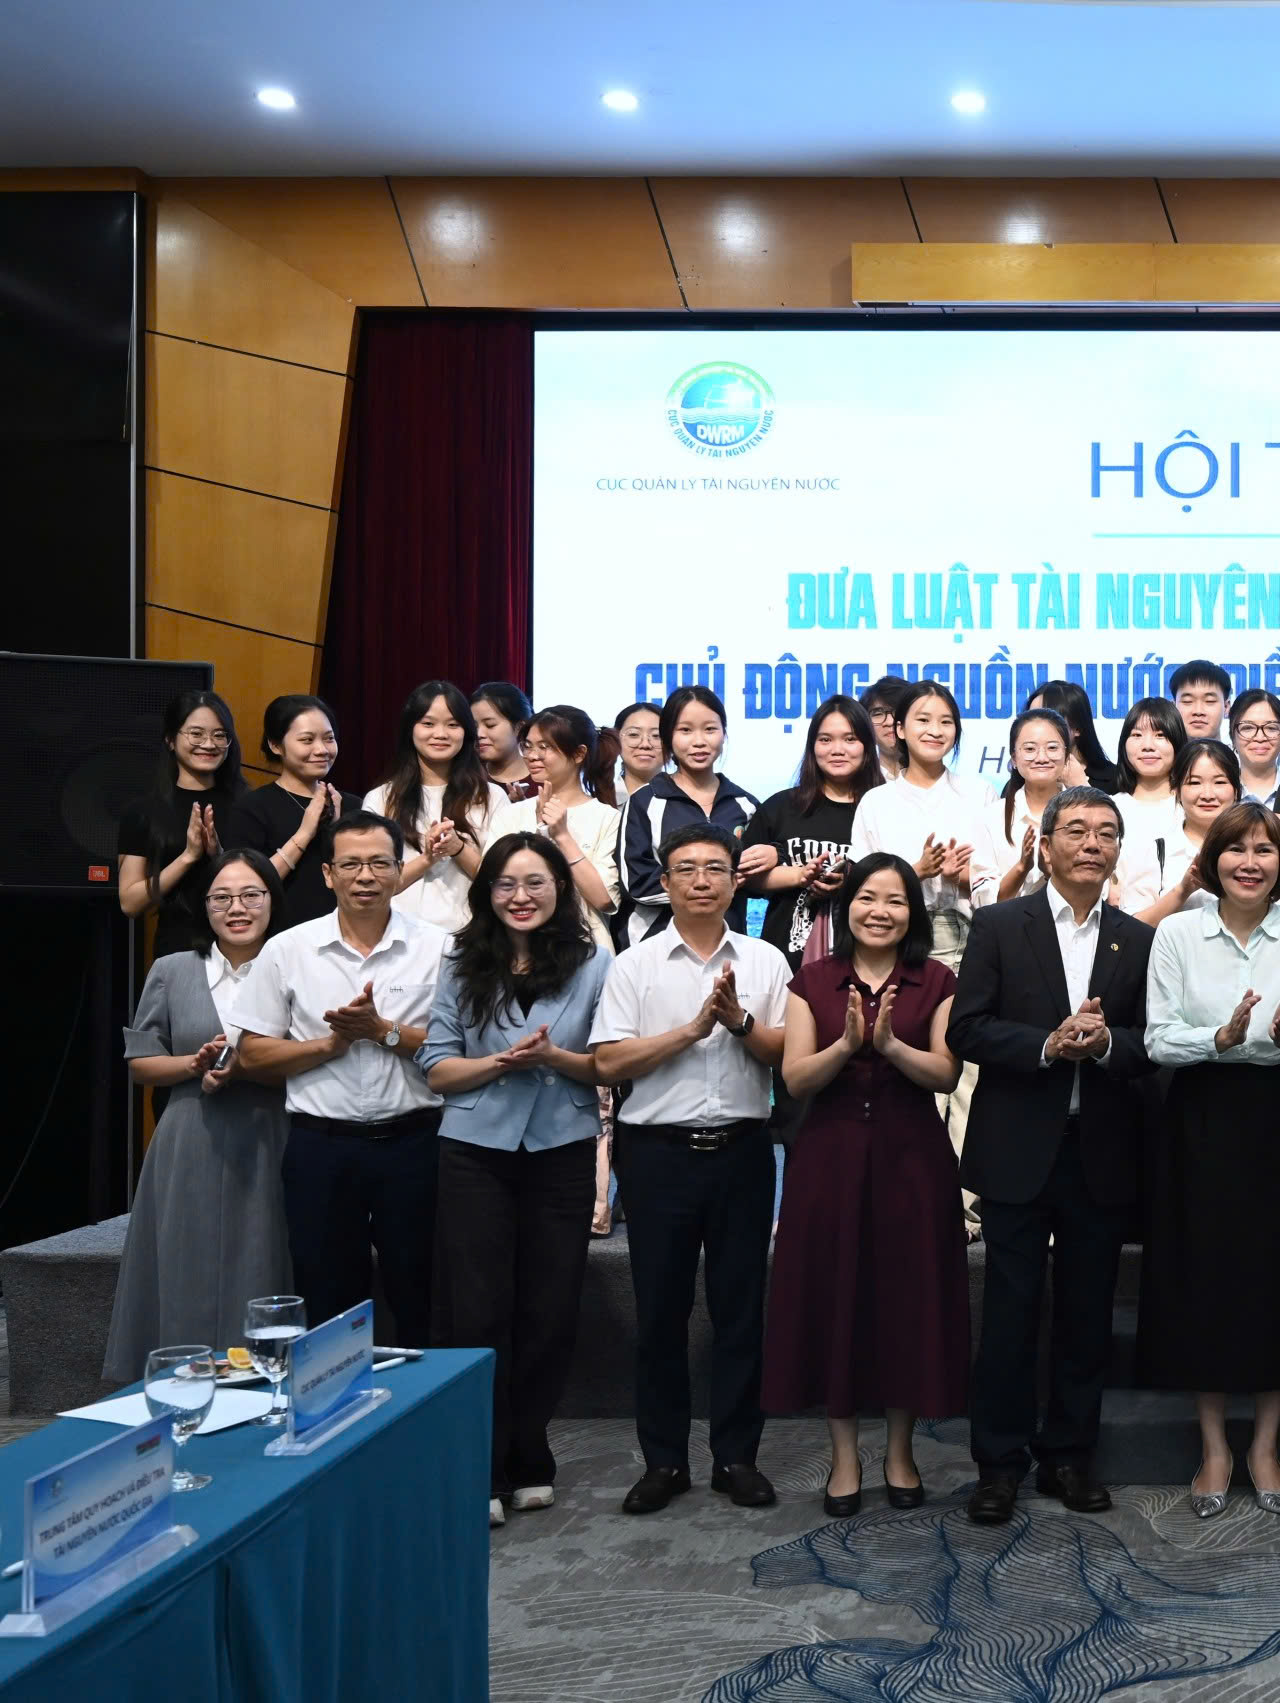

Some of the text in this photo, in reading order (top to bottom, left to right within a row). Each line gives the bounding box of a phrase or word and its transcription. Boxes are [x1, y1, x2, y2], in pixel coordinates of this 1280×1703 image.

[696, 424, 745, 445] DWRM
[1091, 429, 1240, 513] HỘI
[786, 565, 877, 630] ĐƯA
[892, 561, 999, 644] LUẬT
[1011, 562, 1081, 630] TÀI
[742, 653, 870, 734] ĐỘNG
[886, 645, 1049, 720] UỒN
